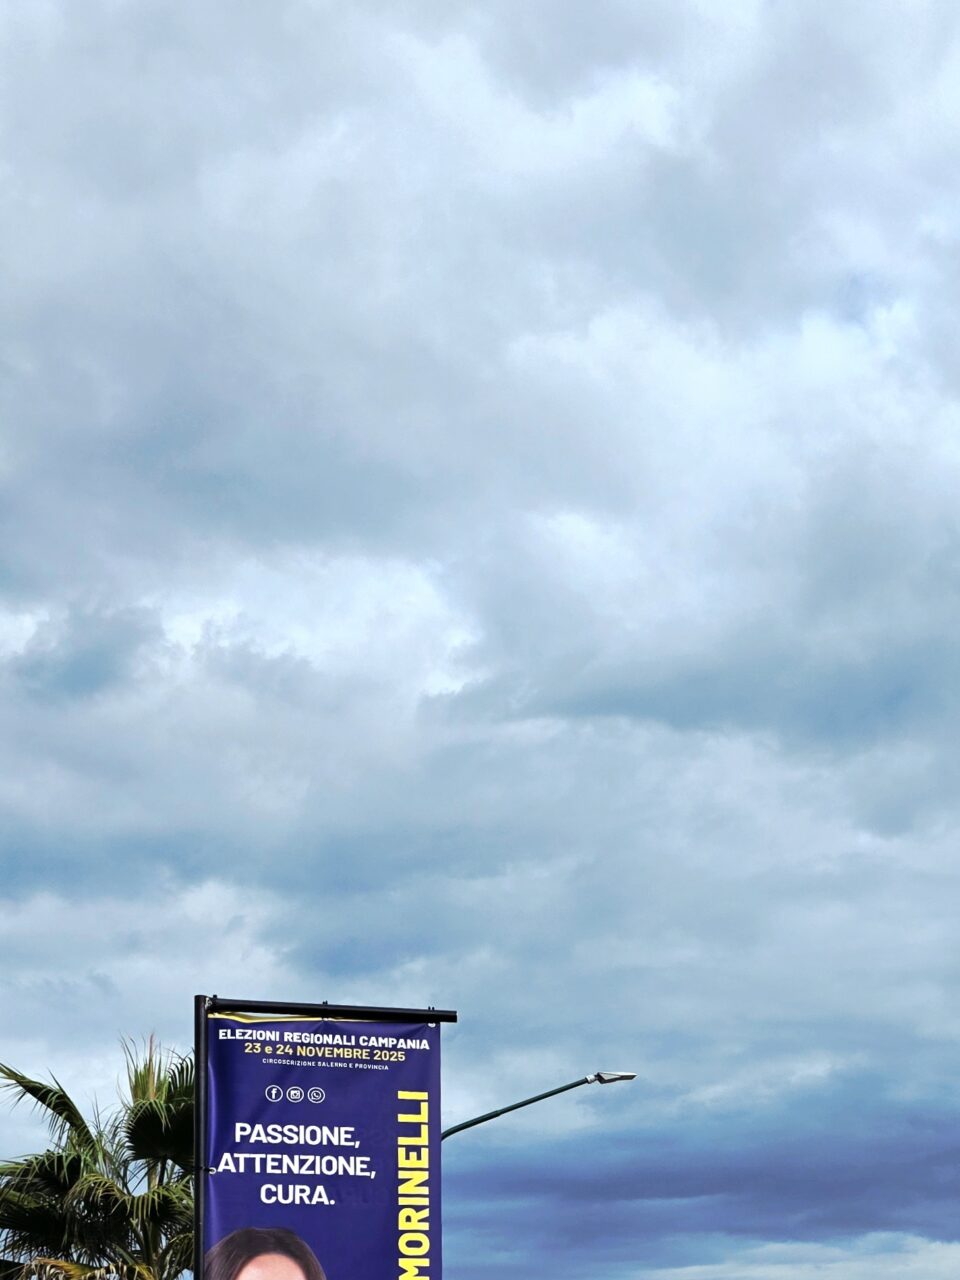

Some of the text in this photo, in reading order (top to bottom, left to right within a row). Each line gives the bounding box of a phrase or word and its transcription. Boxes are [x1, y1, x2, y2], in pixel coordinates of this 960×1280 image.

[218, 1029, 430, 1050] ELEZIONI REGIONALI CAMPANIA
[244, 1042, 406, 1062] 23 e 24 NOVEMBRE 2025
[262, 1058, 316, 1067] CIRCOSCRIZIONE
[234, 1122, 361, 1149] PASSIONE,
[217, 1152, 376, 1179] ATTENZIONE,
[260, 1183, 335, 1205] CURA.
